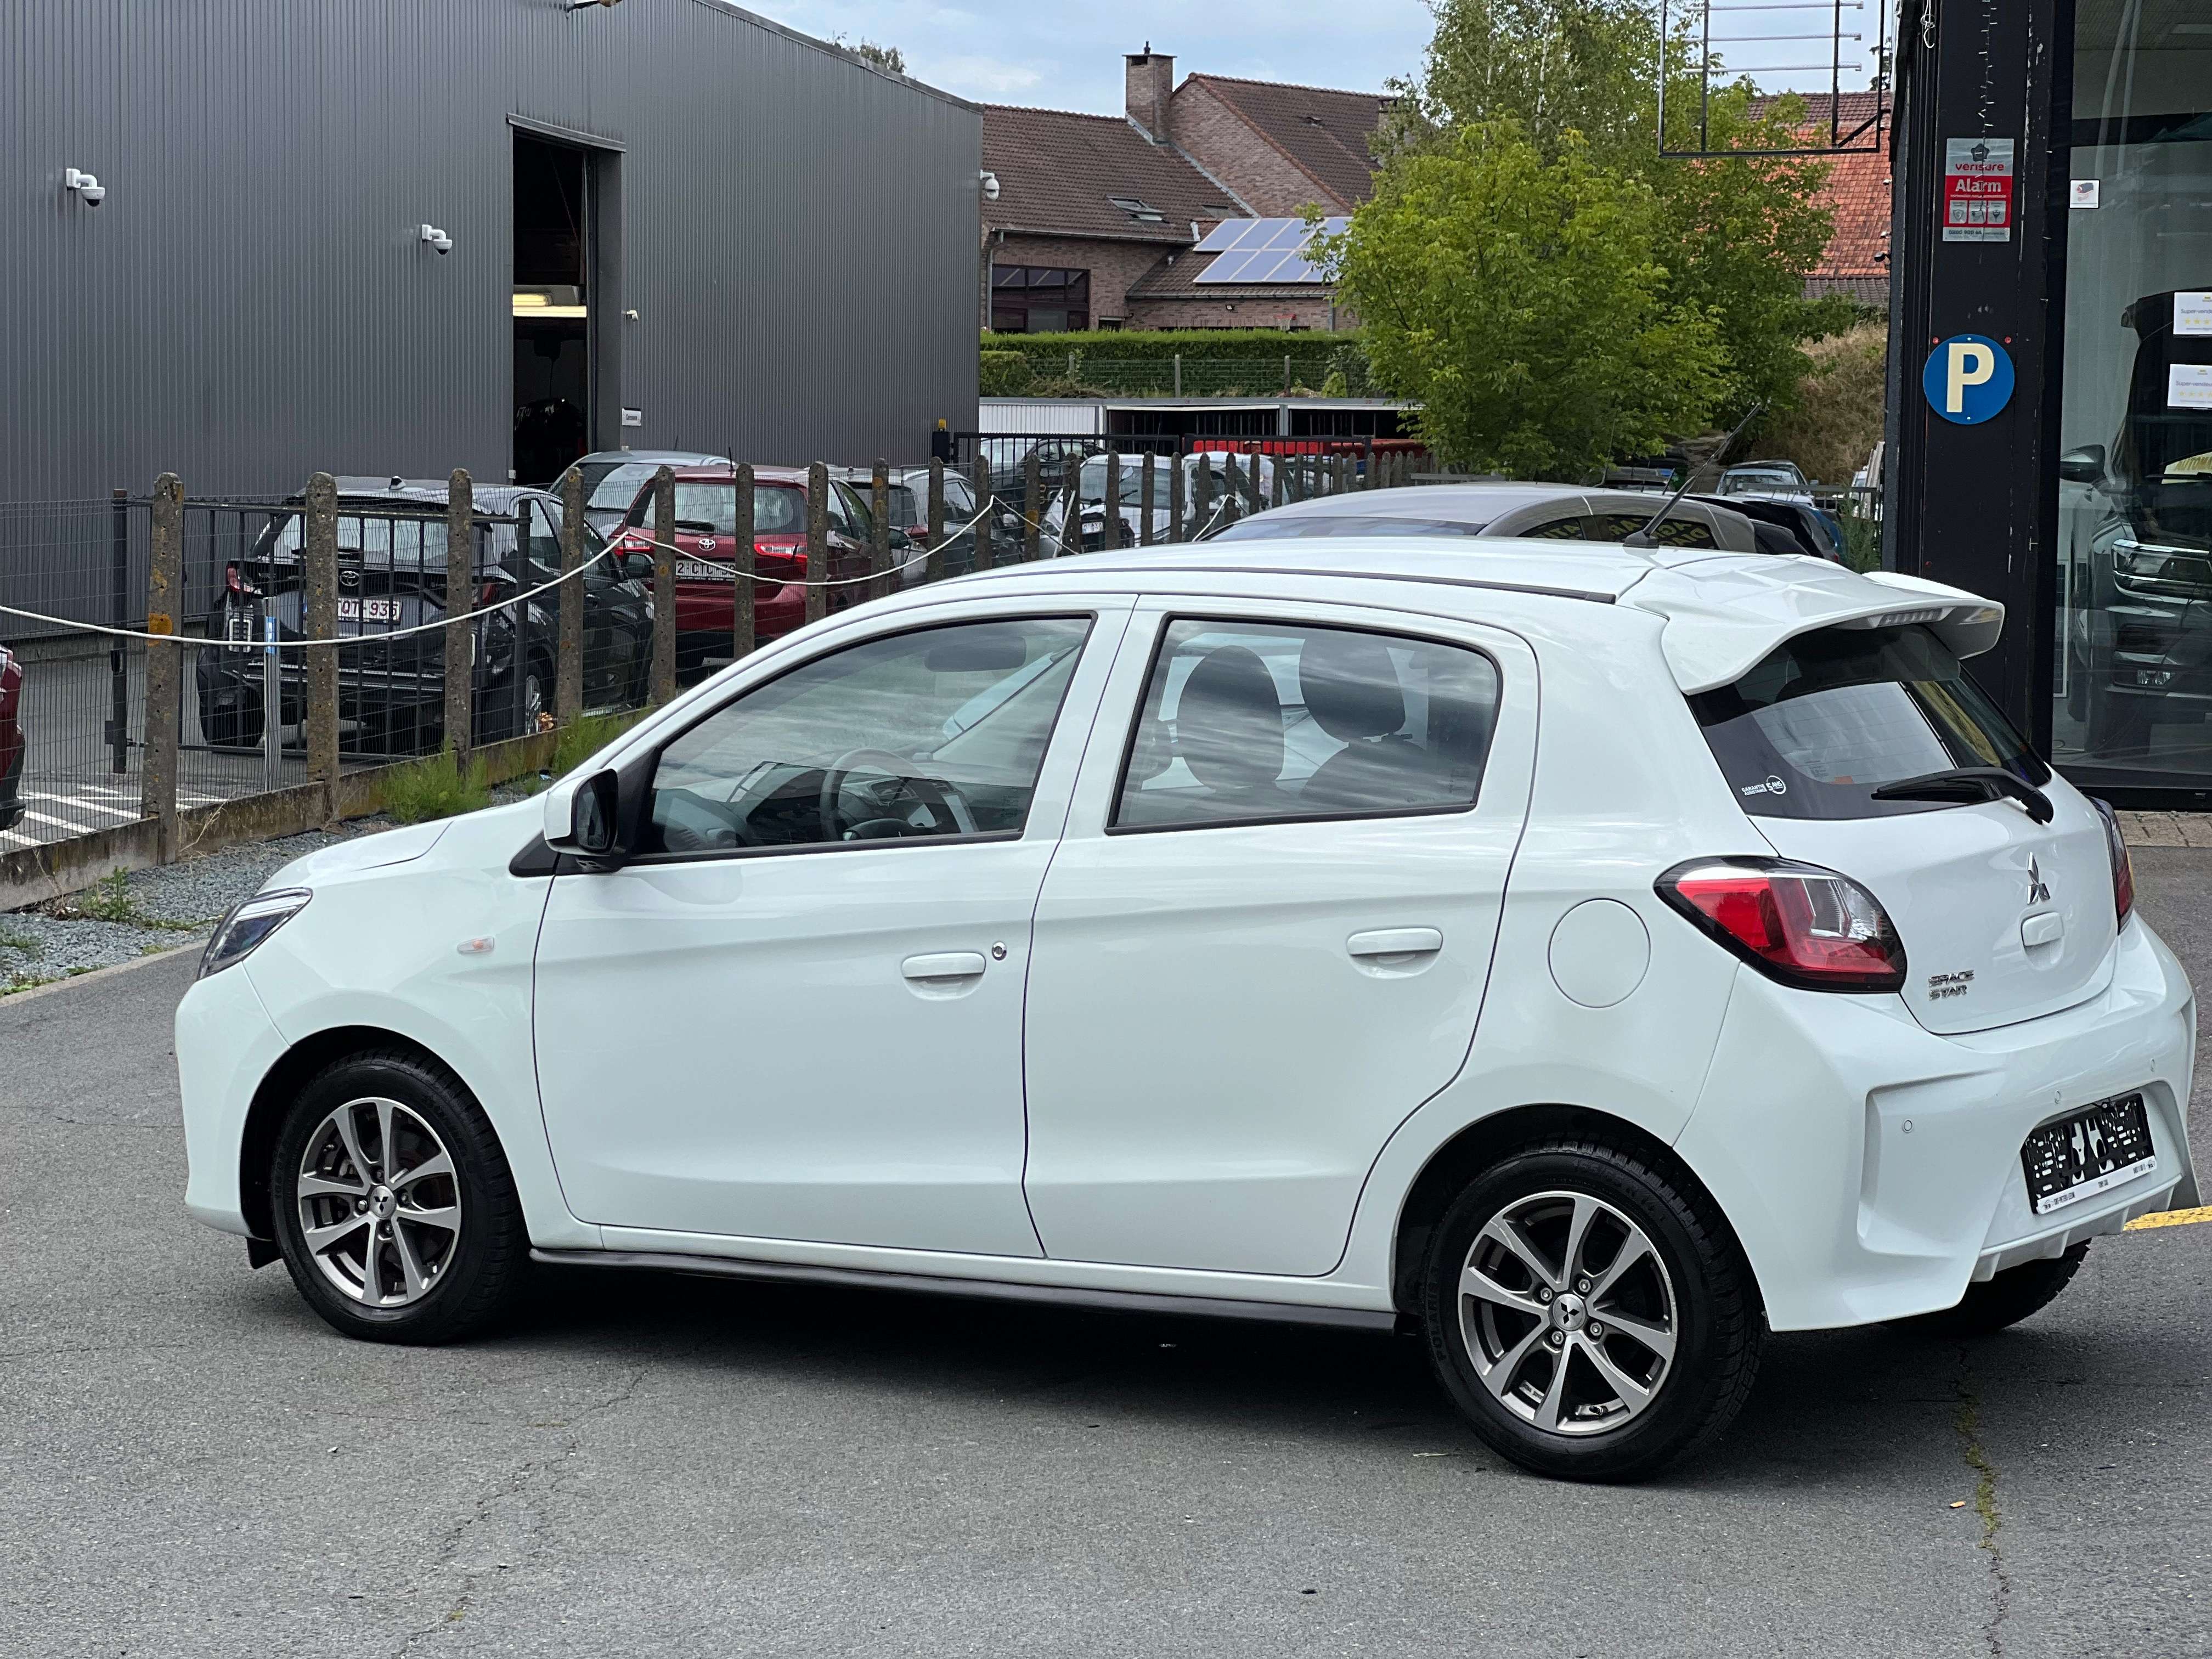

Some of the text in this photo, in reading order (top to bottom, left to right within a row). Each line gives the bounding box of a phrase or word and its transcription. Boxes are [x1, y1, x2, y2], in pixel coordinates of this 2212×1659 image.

[1955, 178, 2001, 193] Alarm
[1946, 343, 1994, 413] P
[1765, 783, 1773, 791] 5
[1928, 969, 1975, 988] SPACE
[1929, 984, 1967, 1001] STAR
